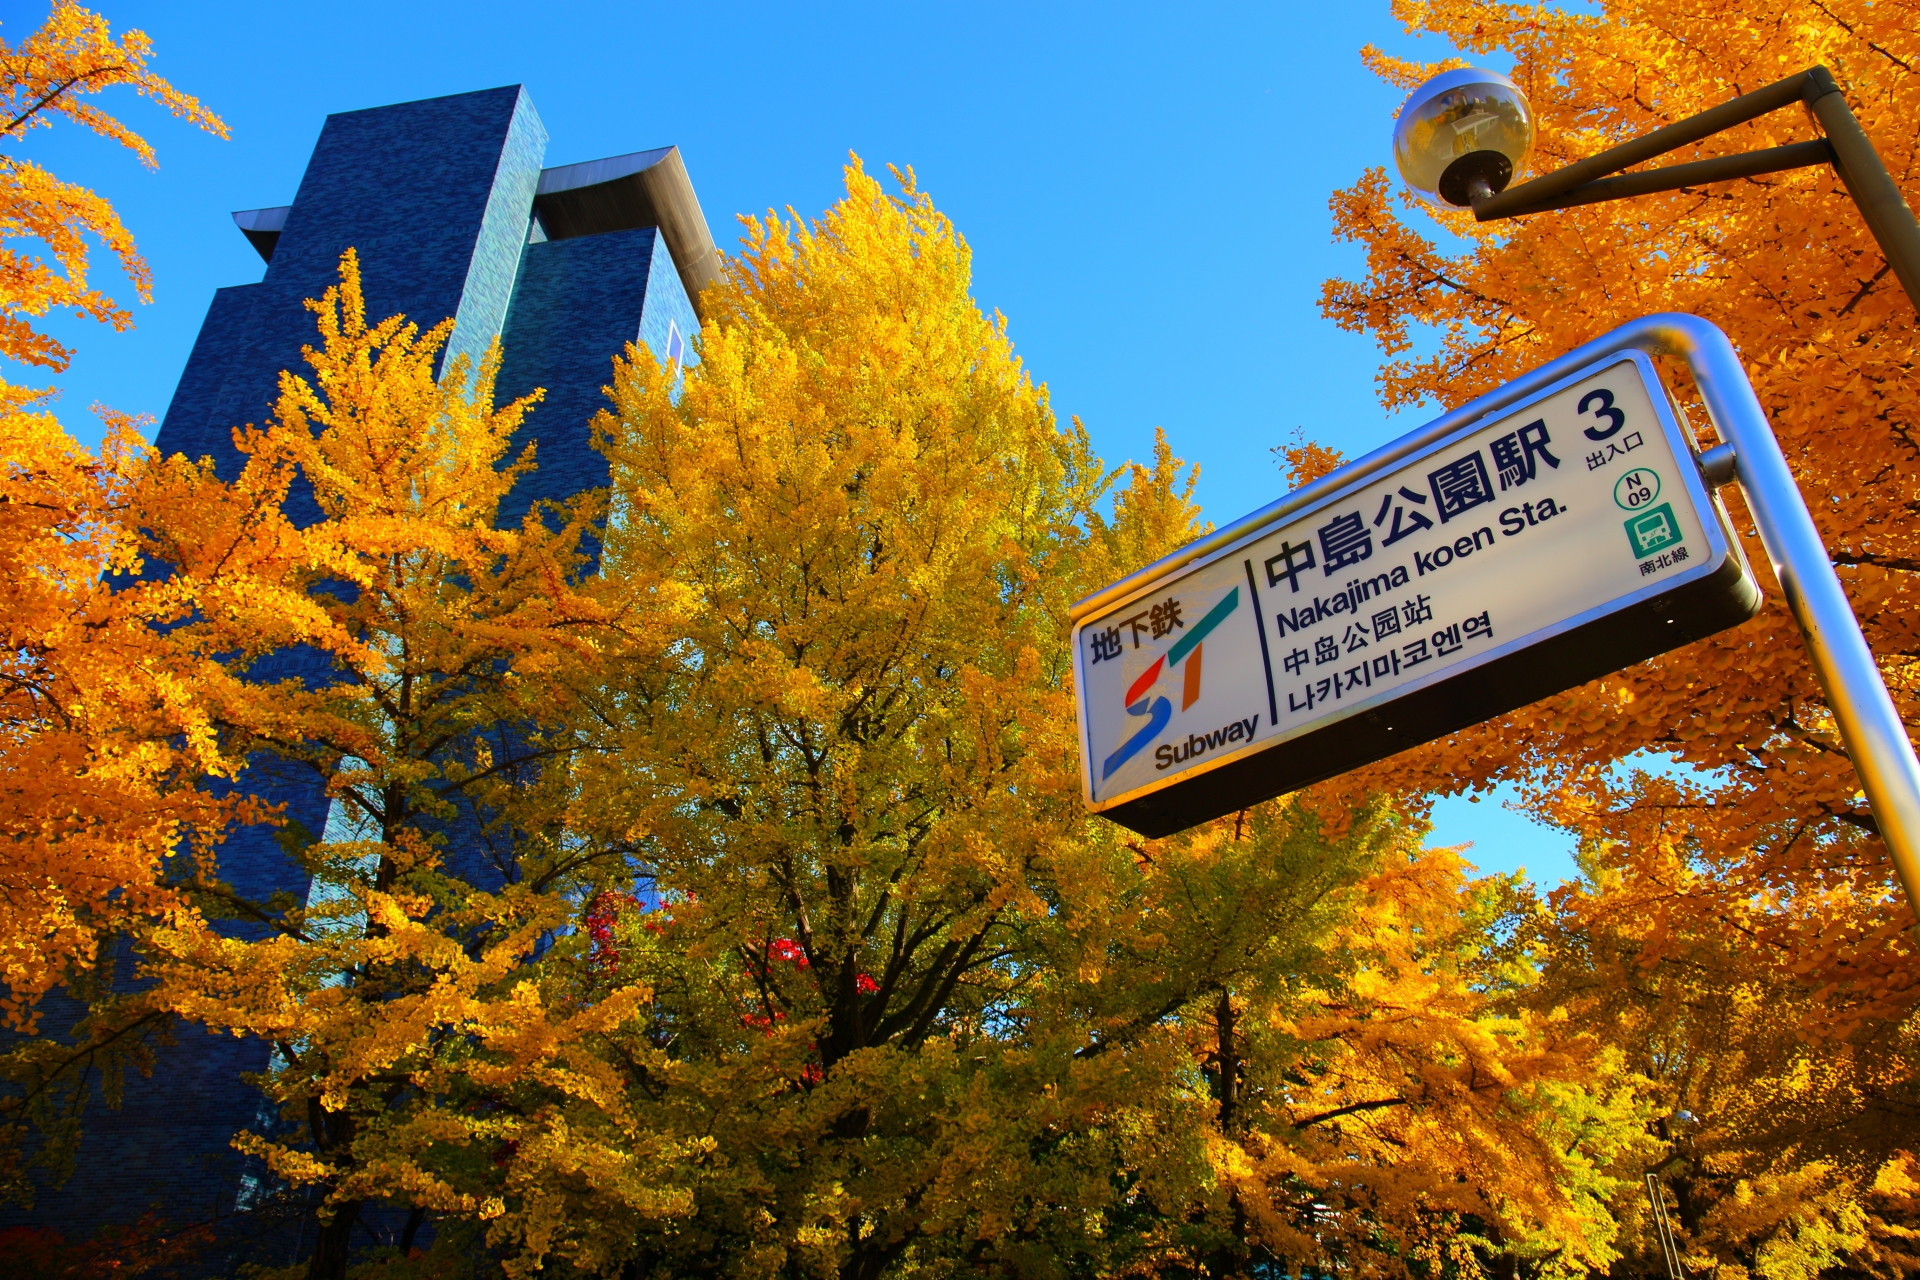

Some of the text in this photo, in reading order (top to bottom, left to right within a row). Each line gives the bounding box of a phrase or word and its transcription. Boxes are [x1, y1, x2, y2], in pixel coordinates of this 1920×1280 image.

[1577, 388, 1625, 442] 3
[1586, 431, 1644, 471] 出入口
[1263, 418, 1561, 593] 中島公園駅
[1625, 473, 1642, 490] N
[1628, 487, 1651, 507] 09
[1276, 497, 1567, 638] Nakajima koen Sta.
[1639, 546, 1689, 576] 南北線
[1090, 597, 1184, 665] 地下鉄
[1283, 594, 1433, 676] 中岛公园站
[1288, 610, 1494, 713] 나카지마코엔역
[1155, 714, 1259, 771] Subway
